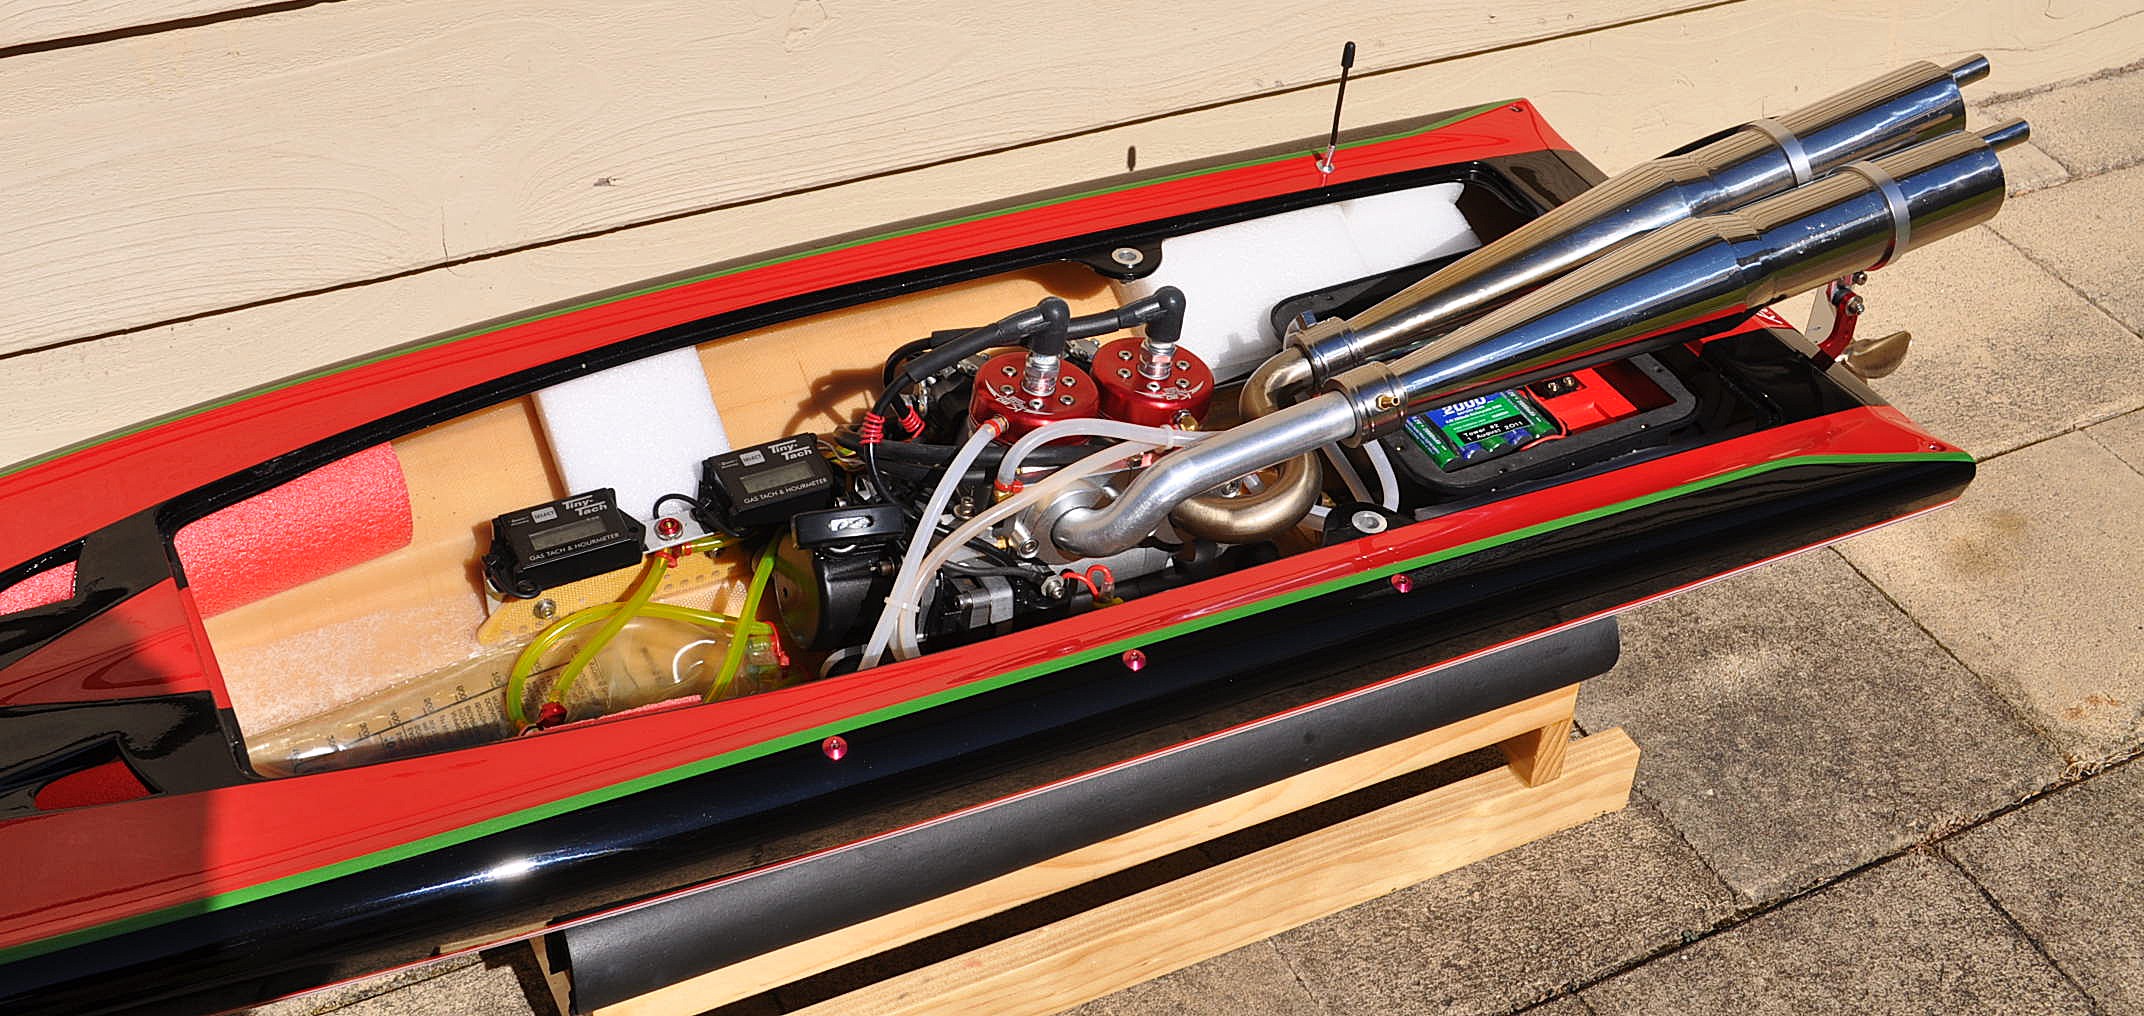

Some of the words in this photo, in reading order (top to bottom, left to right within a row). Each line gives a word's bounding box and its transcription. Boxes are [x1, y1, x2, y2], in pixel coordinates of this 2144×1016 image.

[1463, 428, 1486, 437] Tower
[1477, 428, 1502, 439] August
[1504, 421, 1524, 431] 2011
[781, 445, 813, 461] Tach
[759, 491, 778, 501] TACH
[785, 477, 828, 493] HOURMETER
[575, 501, 608, 516] Tach
[529, 552, 545, 561] GAS
[546, 547, 566, 557] TACH
[575, 532, 620, 549] HOURMETER
